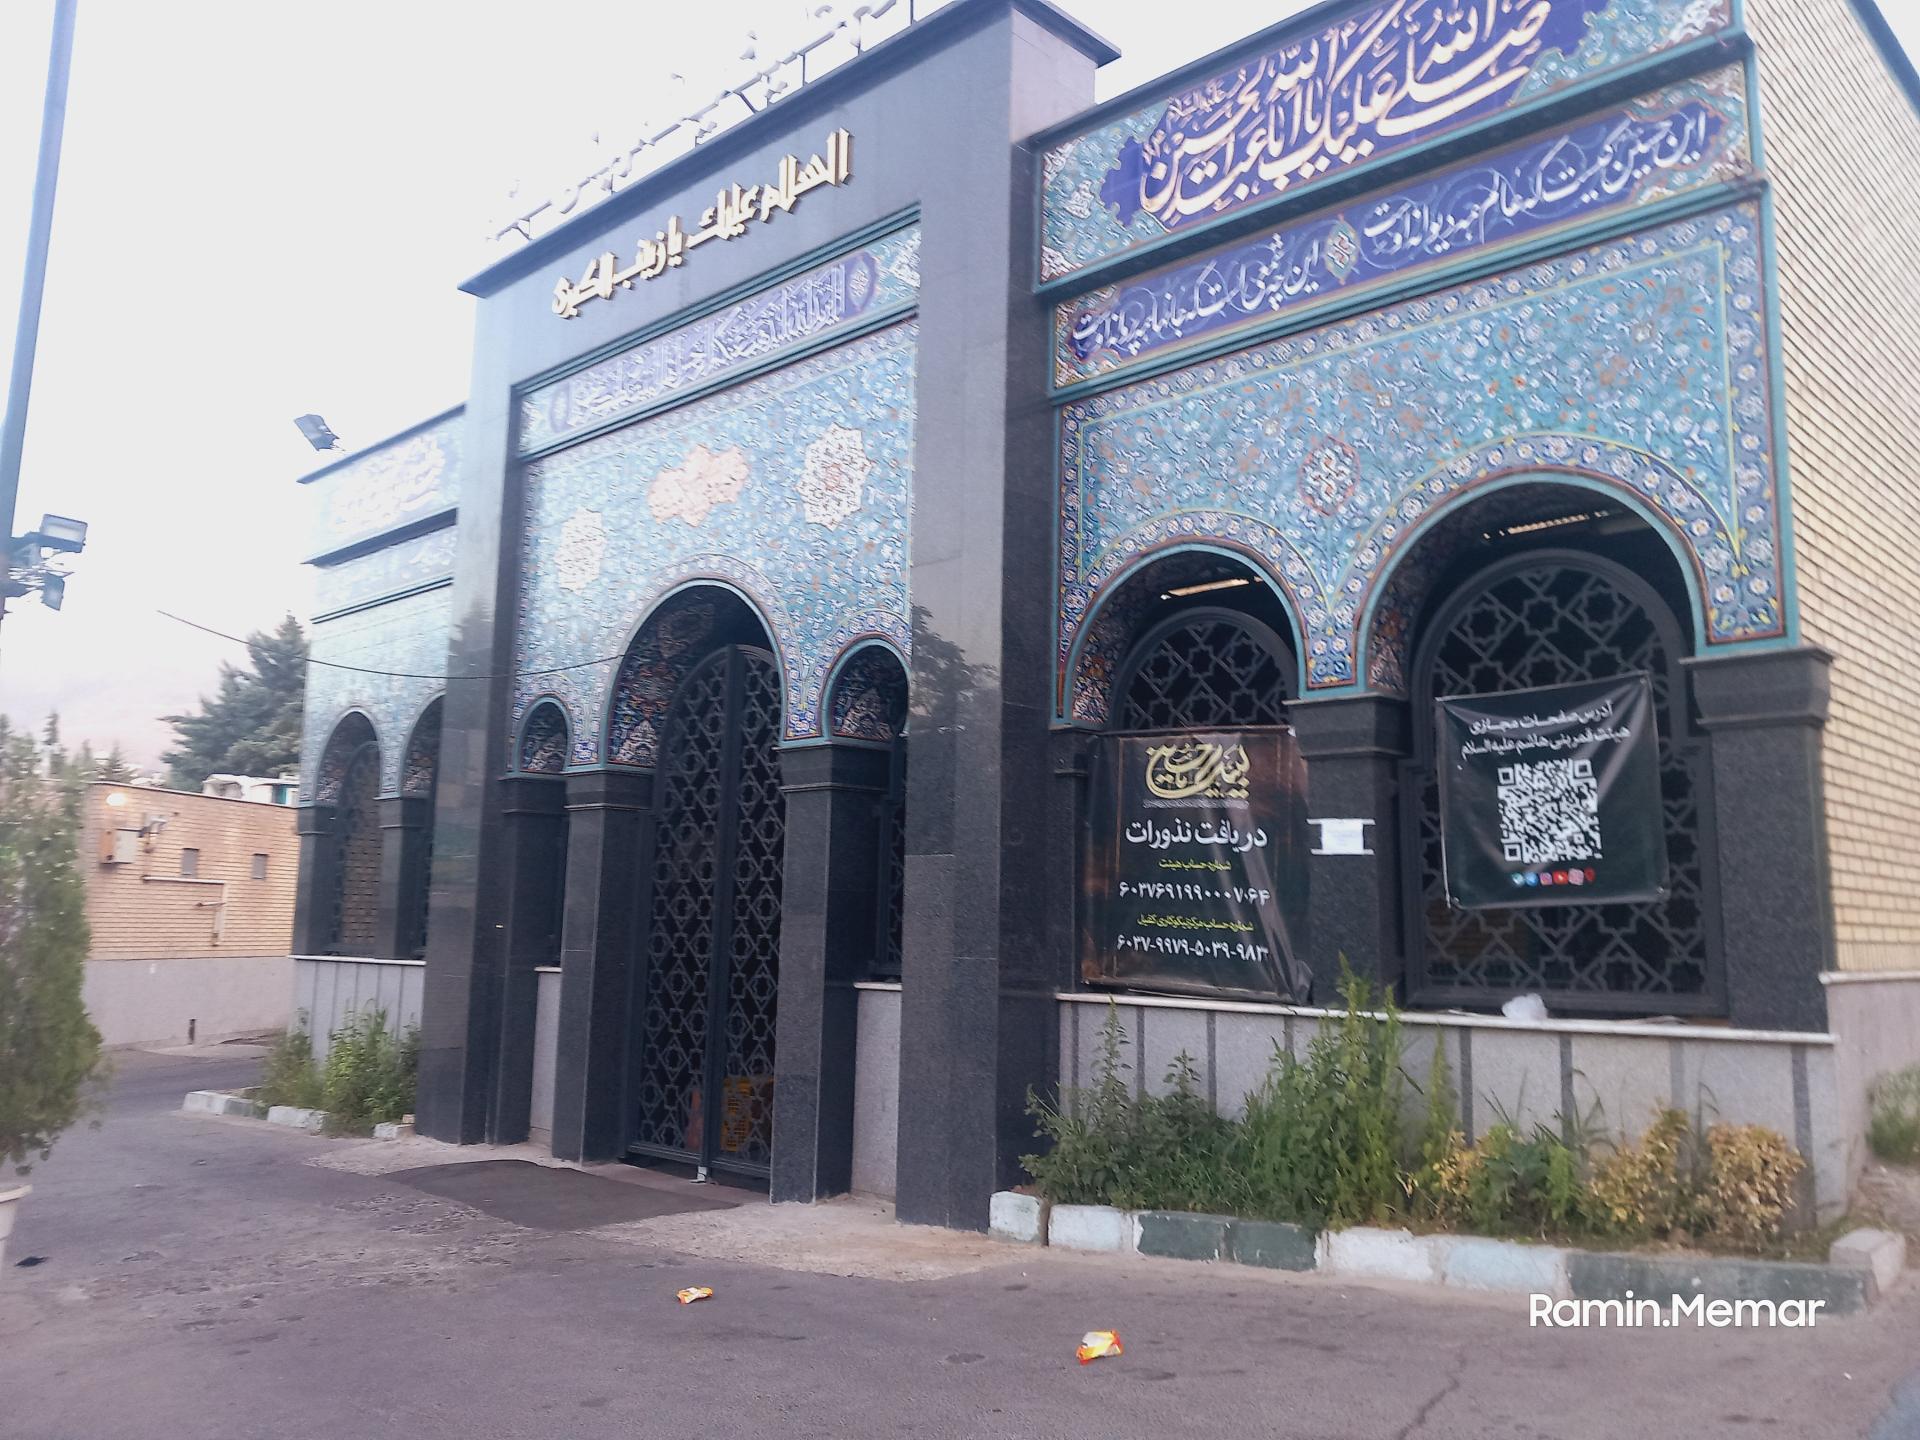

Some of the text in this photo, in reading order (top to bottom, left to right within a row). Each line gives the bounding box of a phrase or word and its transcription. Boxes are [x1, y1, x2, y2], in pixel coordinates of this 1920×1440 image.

[760, 127, 851, 223] السلام
[684, 181, 761, 241] علیک
[613, 230, 668, 290] زینب
[666, 214, 684, 268] یا
[1469, 699, 1613, 735] آدرس صفحات مجازی
[1125, 817, 1268, 853] دریافت نذورات
